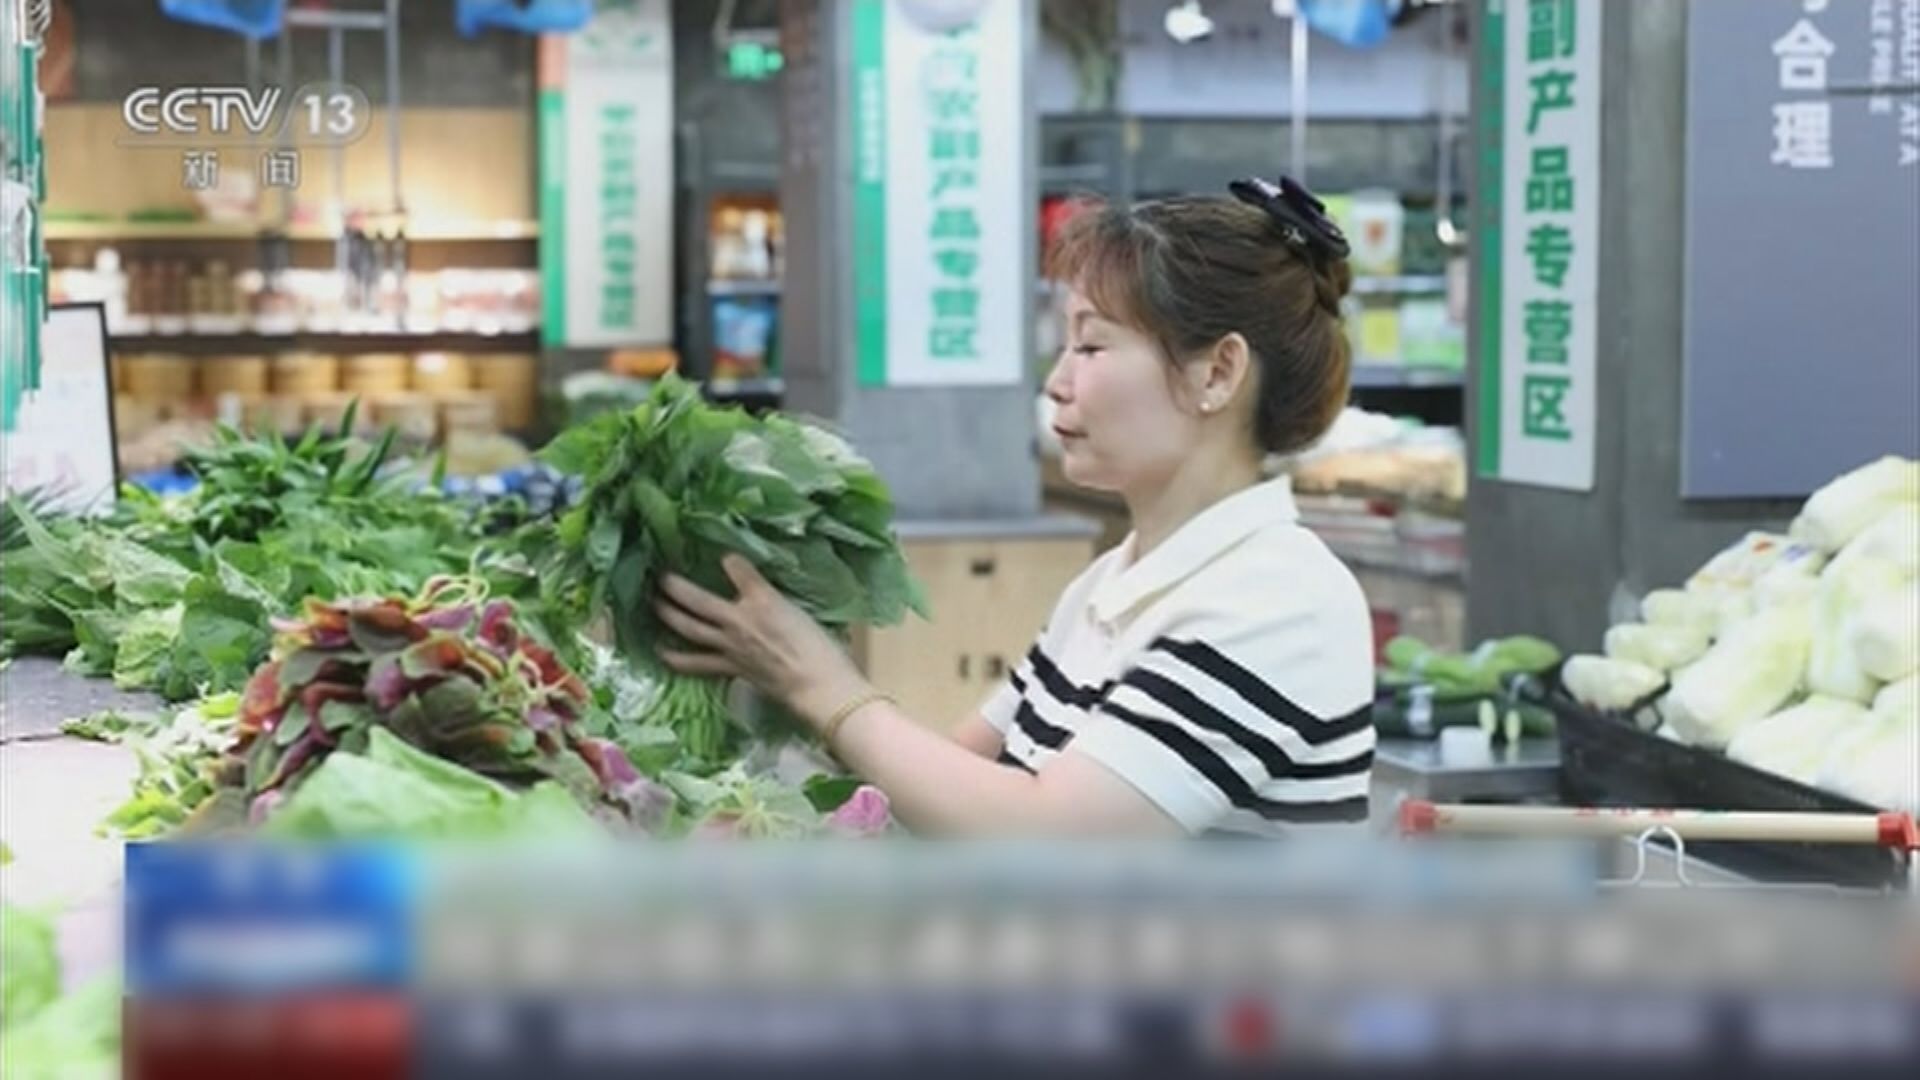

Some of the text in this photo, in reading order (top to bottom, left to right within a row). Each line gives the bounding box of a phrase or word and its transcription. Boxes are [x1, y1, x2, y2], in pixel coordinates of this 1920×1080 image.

[1523, 0, 1576, 441] 副产品专营区
[1769, 0, 1835, 168] 合理
